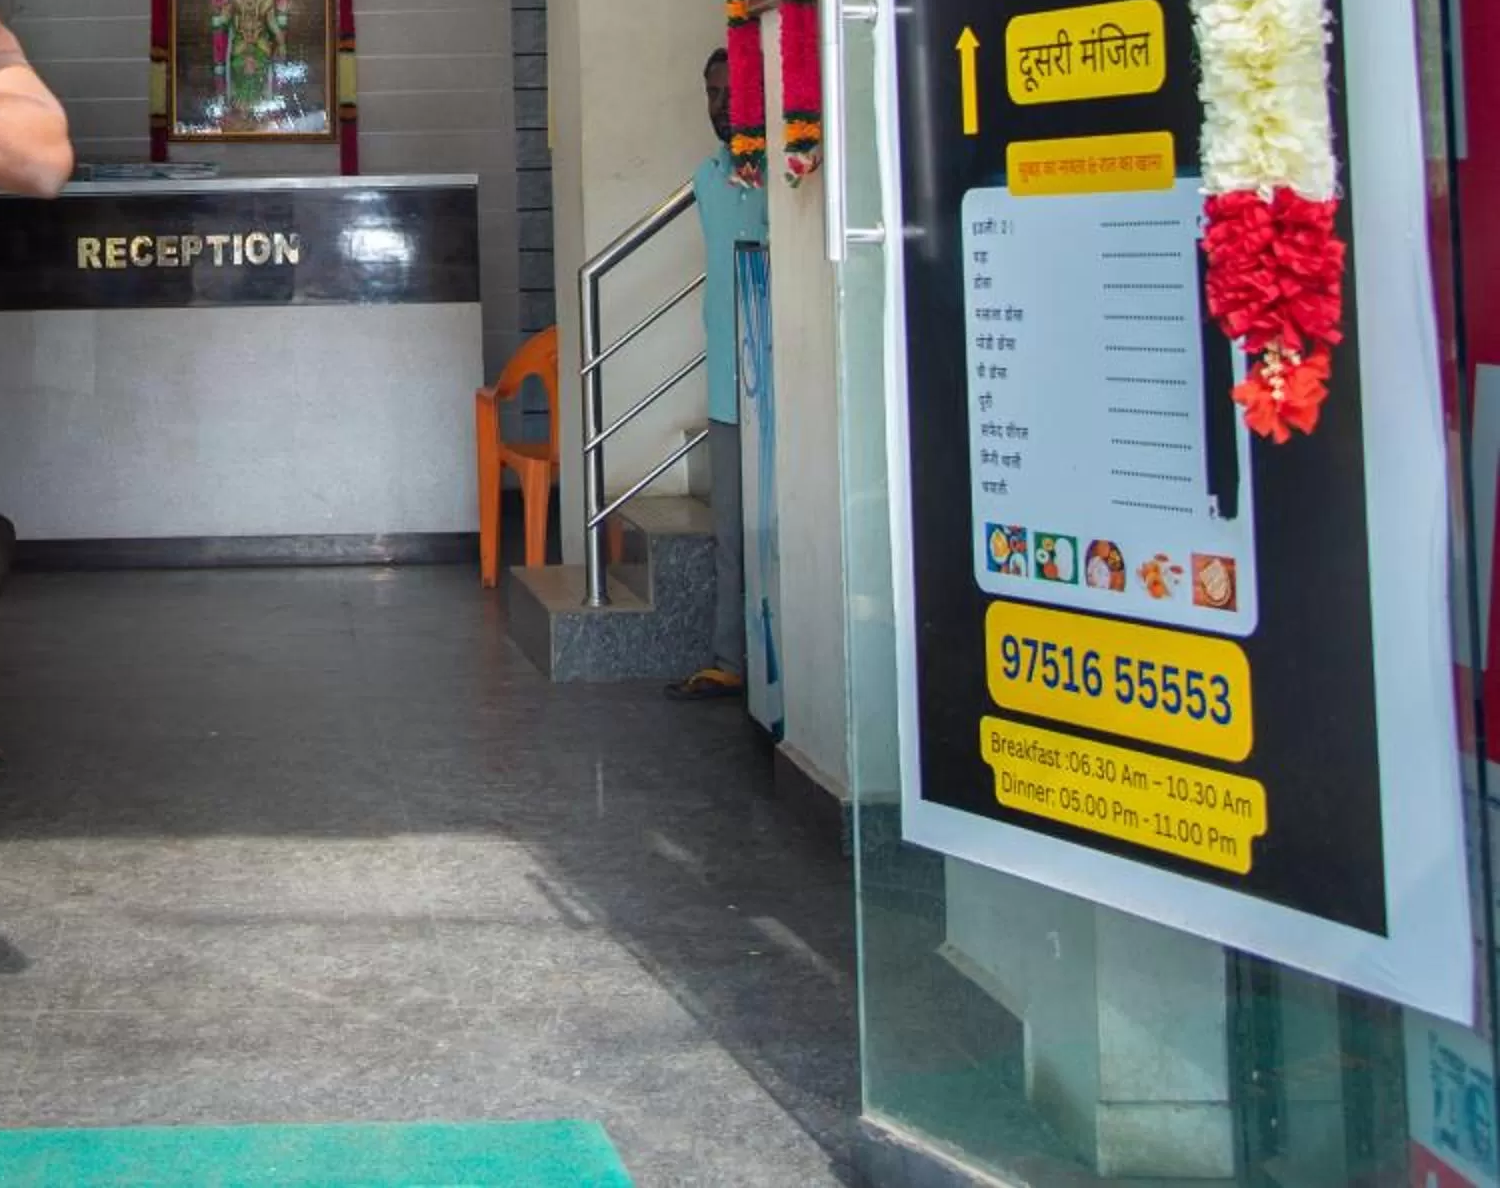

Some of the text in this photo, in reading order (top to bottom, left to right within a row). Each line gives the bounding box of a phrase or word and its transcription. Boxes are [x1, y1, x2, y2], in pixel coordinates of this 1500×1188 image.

[1018, 23, 1151, 92] दूसरी मंजिल
[76, 230, 301, 269] RECEPTION
[1001, 634, 1233, 726] 97516 55553
[991, 732, 1060, 768] Breakfast
[1121, 764, 1150, 789] Am
[1167, 775, 1217, 809] 10.30
[1222, 791, 1253, 818] Am
[1002, 771, 1056, 806] Dinner:
[1060, 787, 1108, 819] 05.00
[1113, 801, 1139, 829] Pm
[1154, 813, 1203, 846] 11.00
[1209, 827, 1238, 857] Pm
